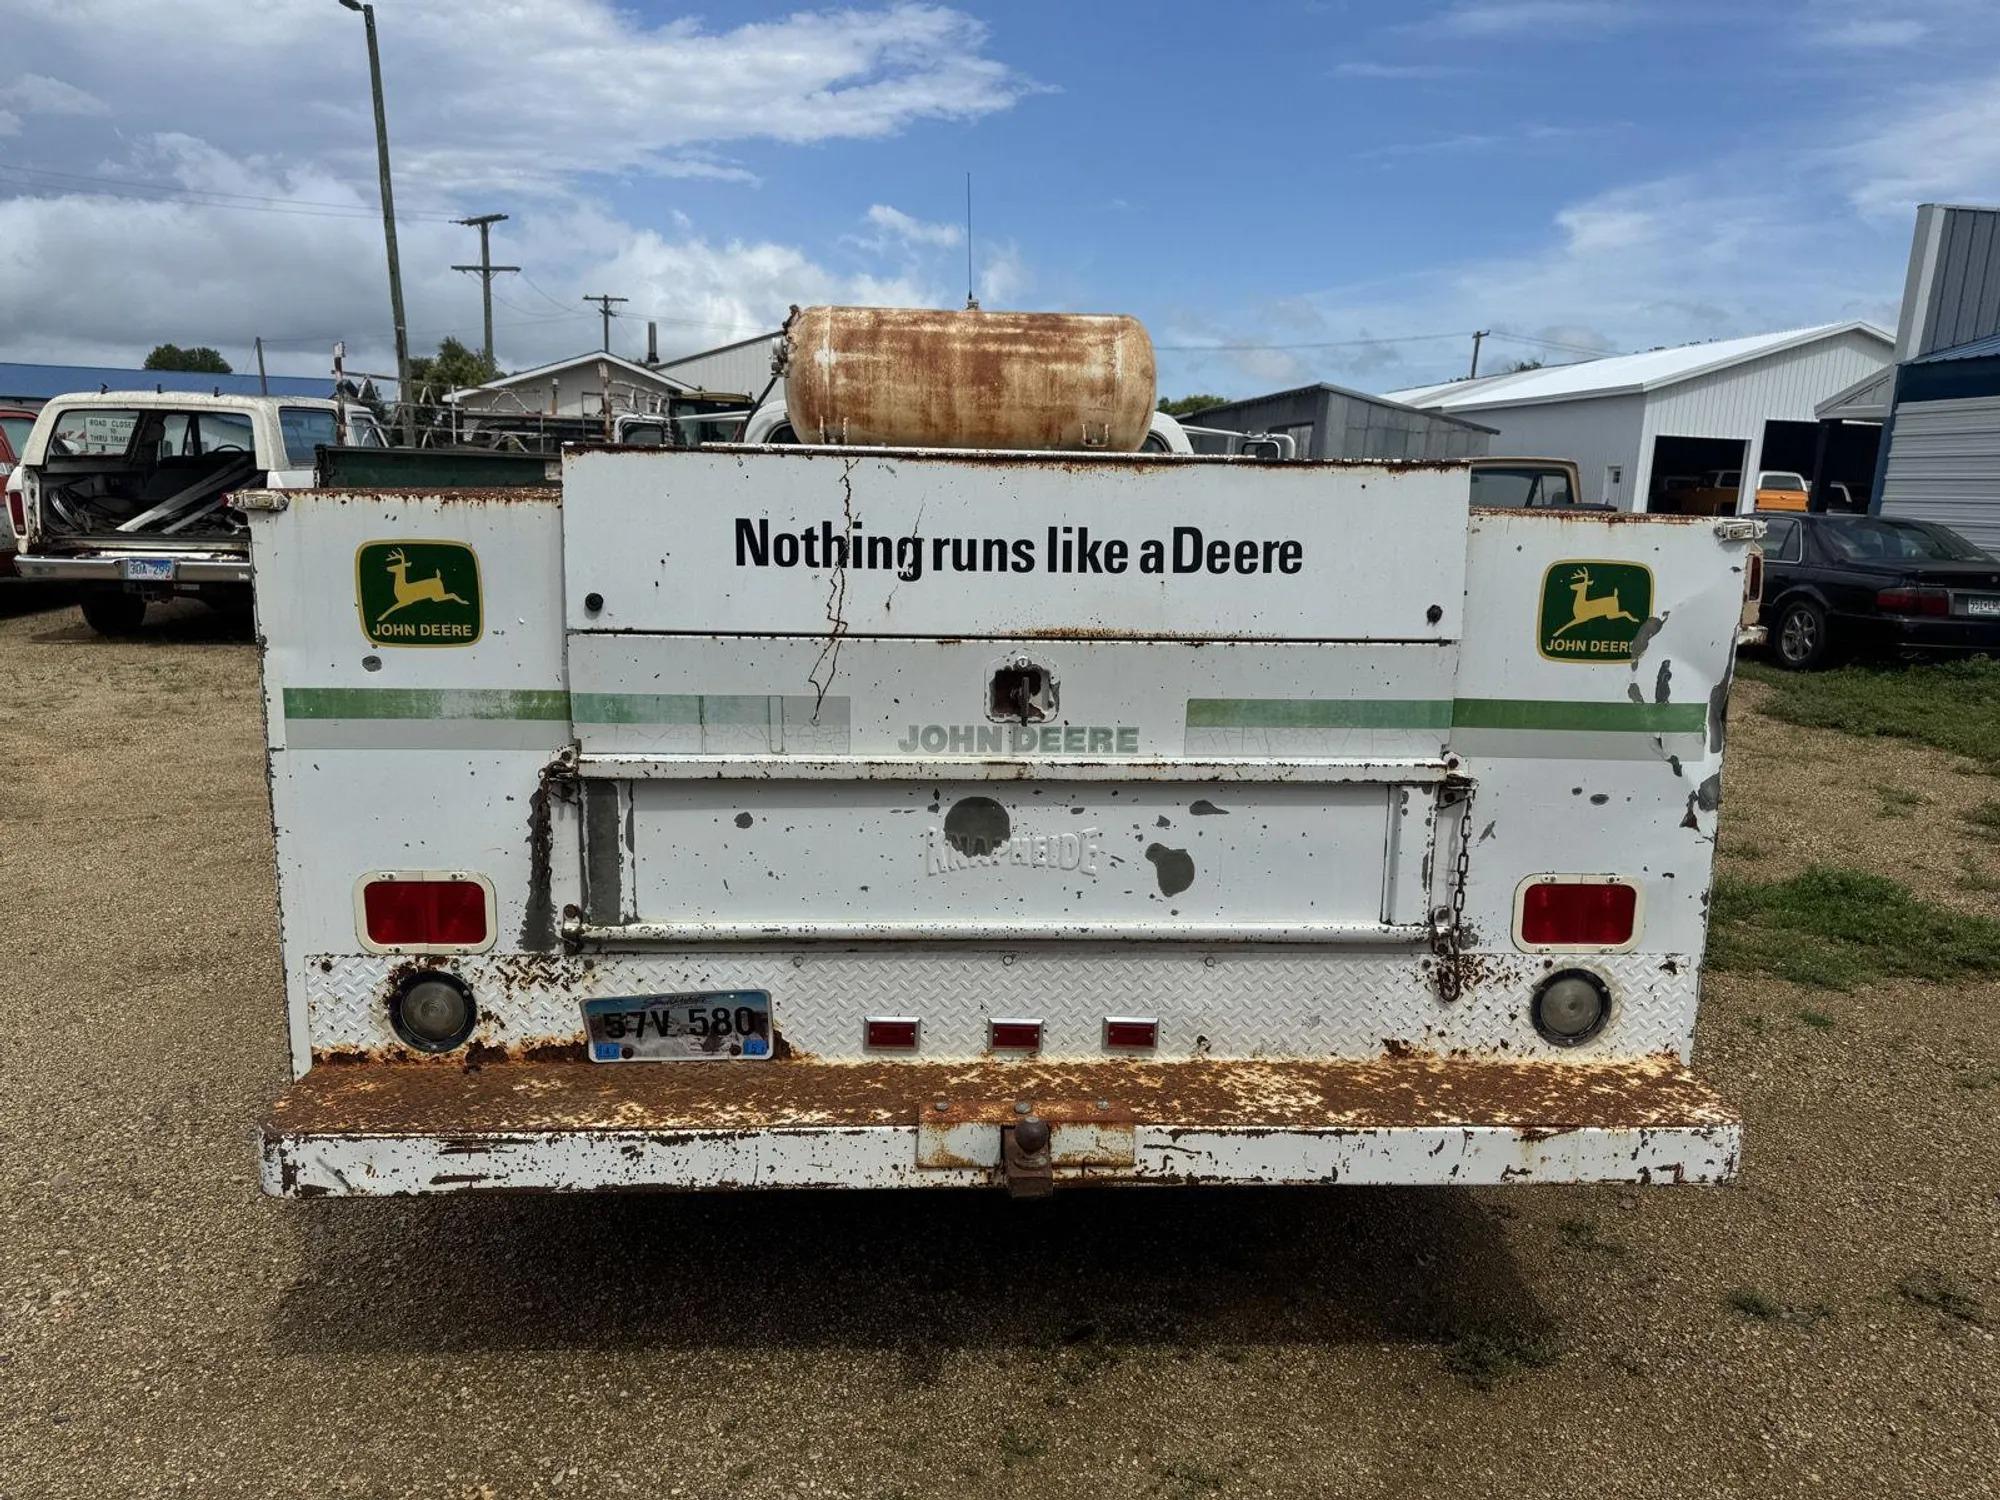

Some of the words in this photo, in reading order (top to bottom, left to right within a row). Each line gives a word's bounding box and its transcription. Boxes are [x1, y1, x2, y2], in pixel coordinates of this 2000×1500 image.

[89, 419, 107, 427] ROAD
[90, 434, 108, 442] THRU
[735, 518, 924, 582] Nothing
[932, 537, 1035, 573] runs
[1047, 526, 1128, 574] like
[1139, 540, 1164, 574] a
[1172, 526, 1303, 574] Deere
[373, 624, 416, 636] JOHN
[420, 624, 473, 637] DEERE
[1546, 639, 1587, 651] JOHN
[898, 724, 1003, 753] JOHN
[1012, 726, 1140, 754] DEERE
[603, 1010, 672, 1039] 57V
[688, 1006, 755, 1037] 580
